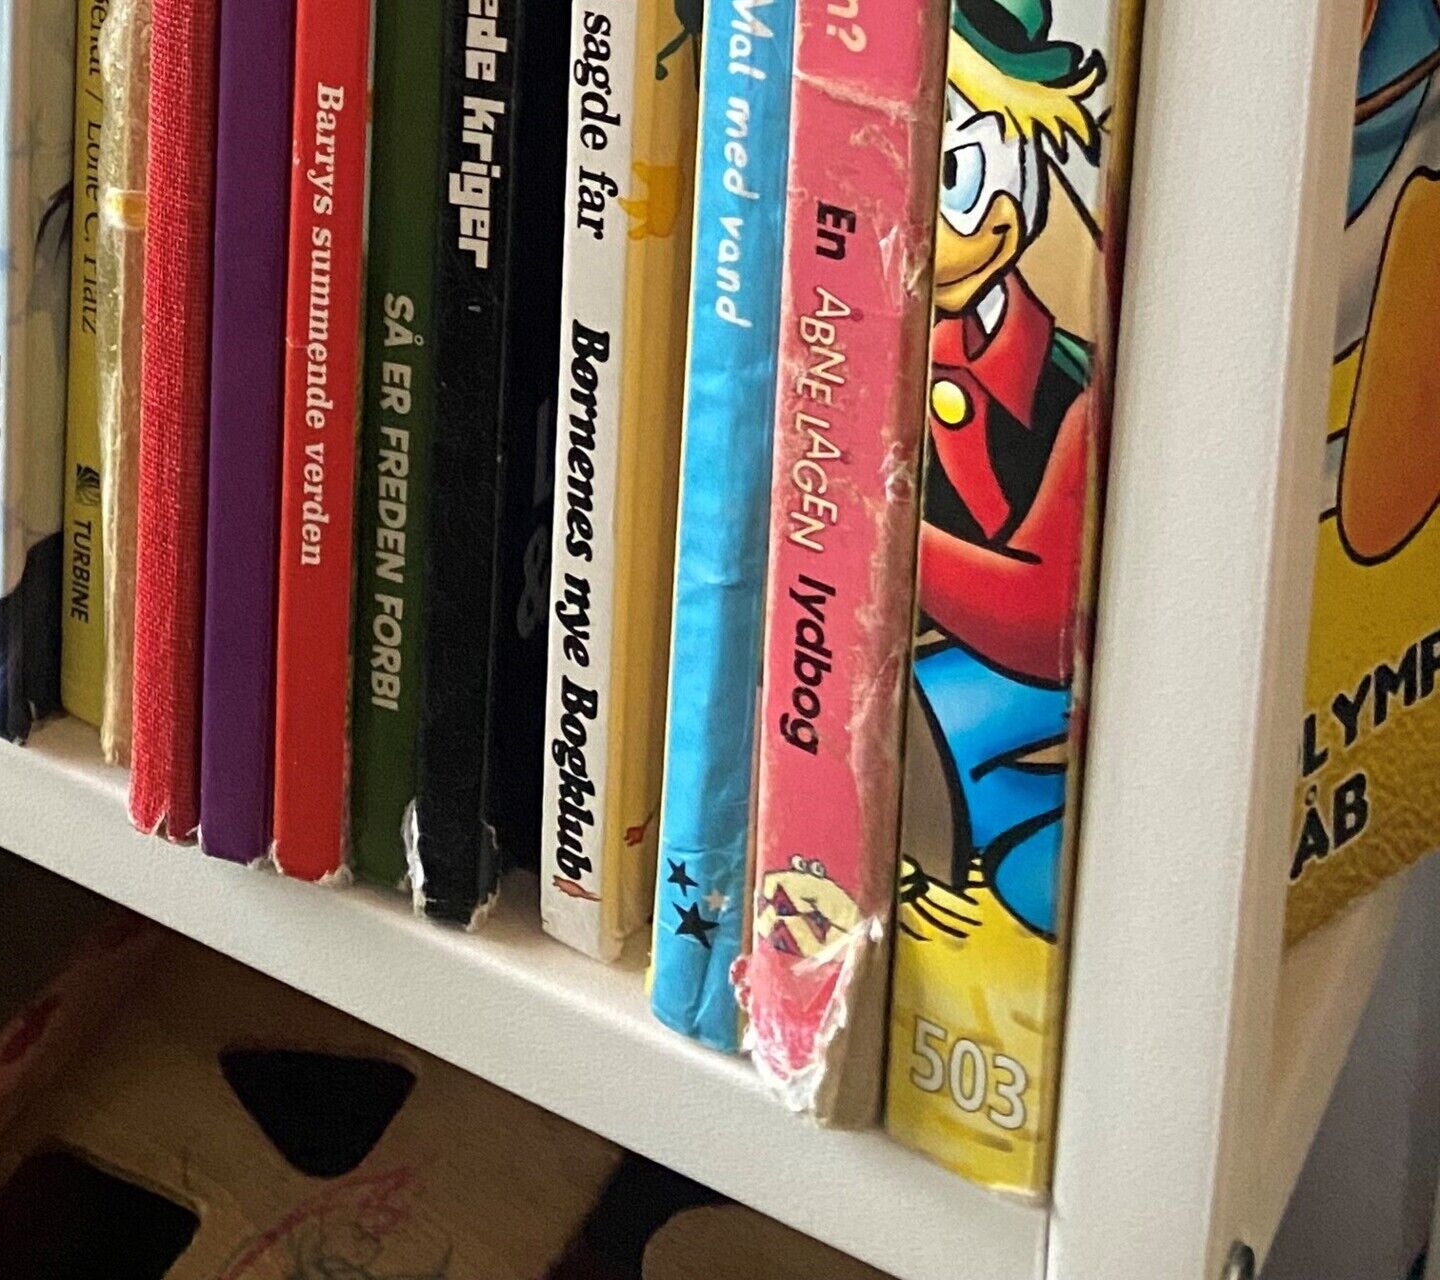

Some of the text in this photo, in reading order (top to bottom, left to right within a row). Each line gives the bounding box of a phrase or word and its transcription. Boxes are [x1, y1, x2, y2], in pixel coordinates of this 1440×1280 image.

[573, 10, 621, 150] sagde
[307, 81, 345, 214] Barrys
[449, 96, 505, 268] kriger
[577, 165, 619, 239] far
[721, 96, 760, 200] med
[714, 216, 753, 328] vand
[816, 200, 857, 260] En
[304, 226, 334, 429] summende
[300, 441, 330, 566] verden
[369, 293, 424, 711] SÅ ER FREDEN FORBI
[70, 518, 92, 624] TURBINE
[552, 319, 610, 881] Børnenes nye Bogklub
[780, 574, 836, 755] lydbog
[910, 1014, 1028, 1129] 503
